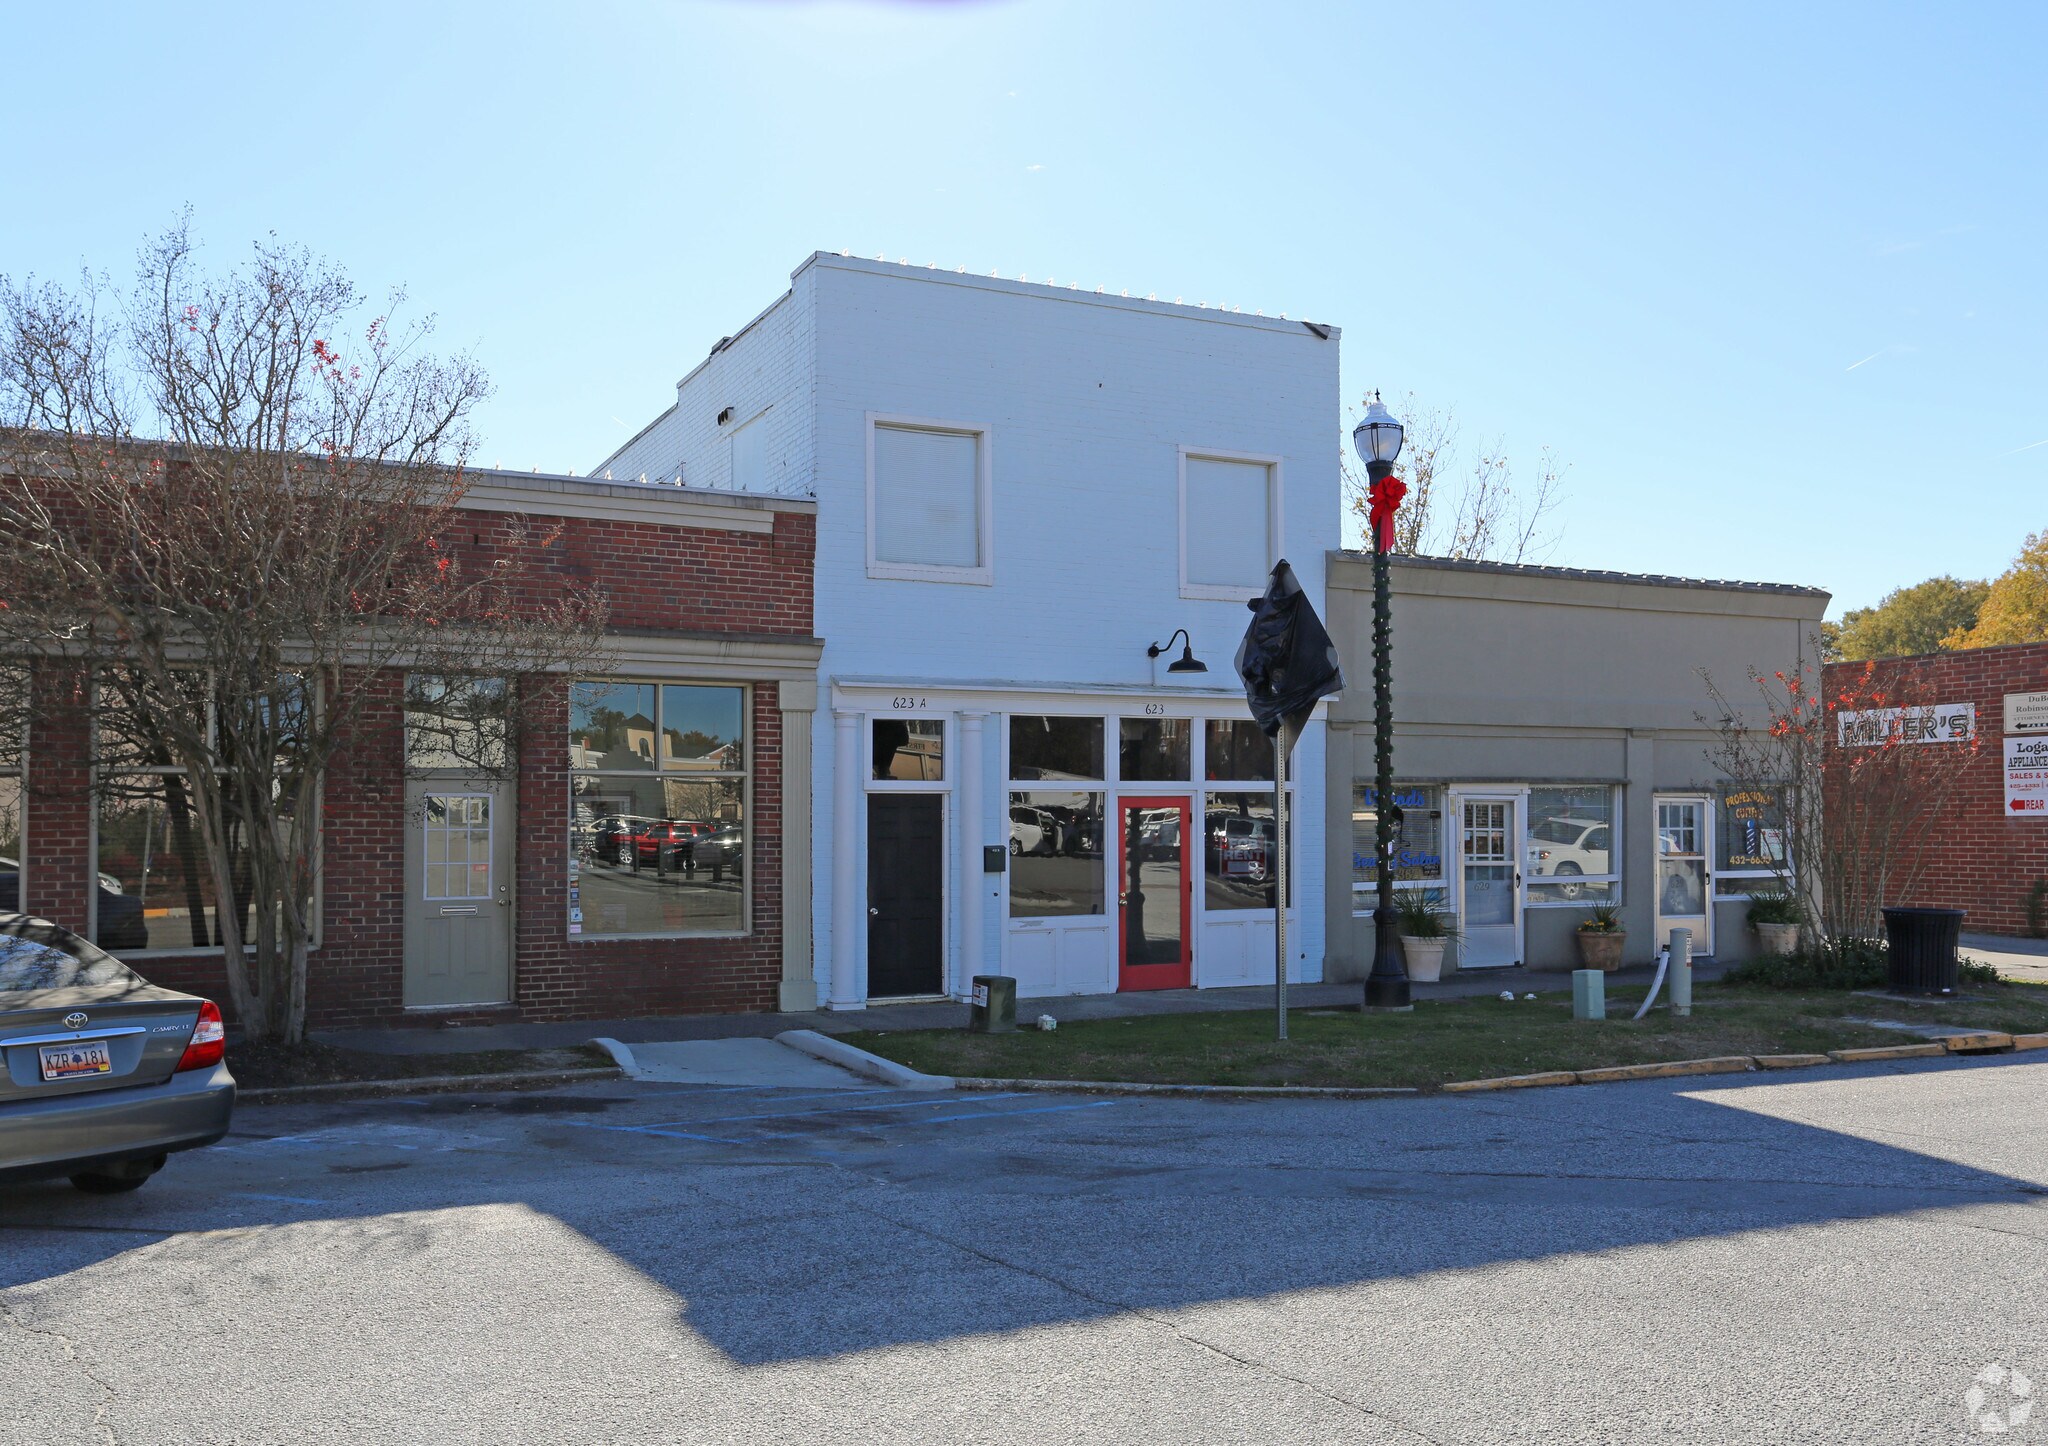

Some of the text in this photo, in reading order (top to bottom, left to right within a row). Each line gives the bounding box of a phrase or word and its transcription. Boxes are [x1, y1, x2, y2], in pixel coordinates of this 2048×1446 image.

[892, 697, 927, 709] 623 A
[1145, 703, 1164, 715] 623
[2026, 799, 2045, 810] REAR
[1223, 850, 1263, 861] RENT
[1474, 881, 1490, 891] 629
[152, 1025, 180, 1033] CAMRY
[45, 1050, 107, 1070] KZR 181
